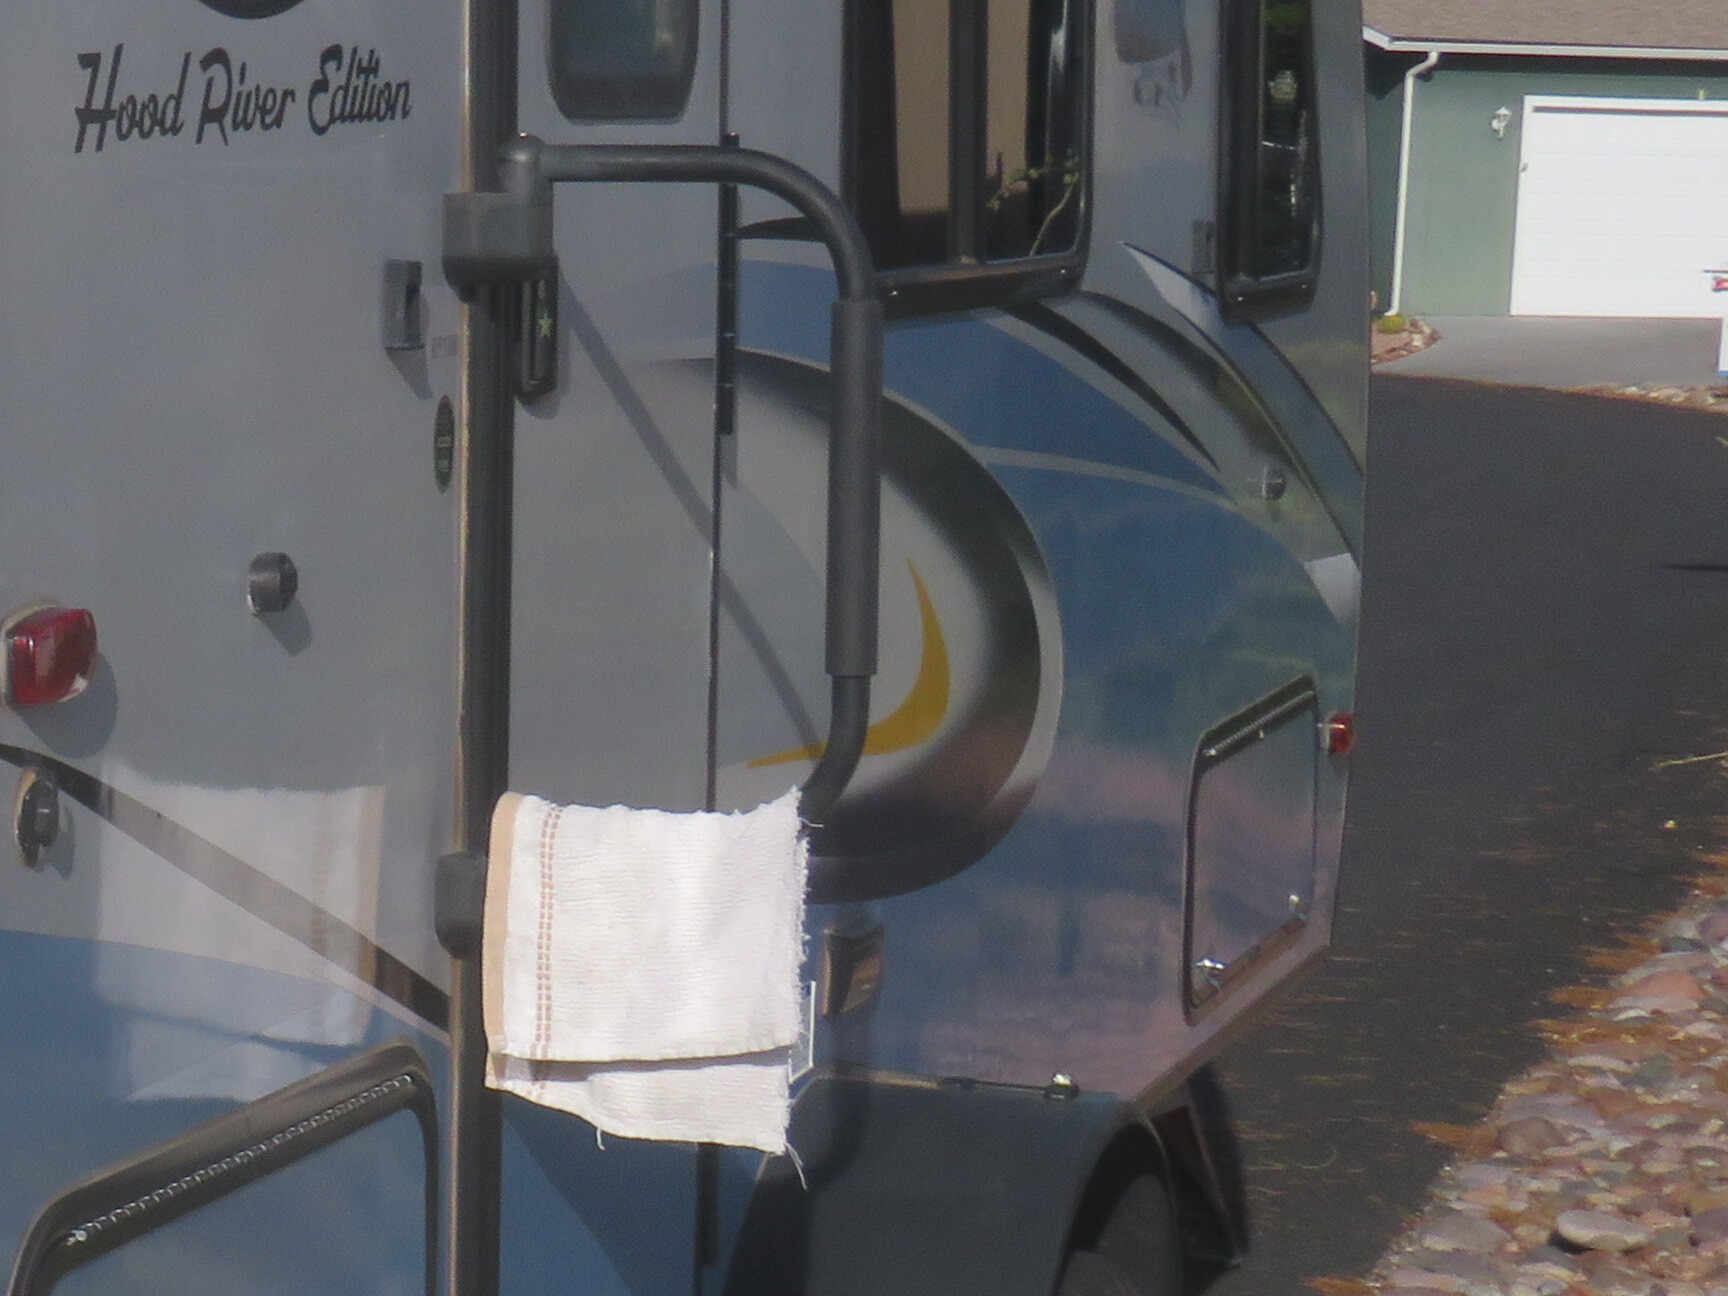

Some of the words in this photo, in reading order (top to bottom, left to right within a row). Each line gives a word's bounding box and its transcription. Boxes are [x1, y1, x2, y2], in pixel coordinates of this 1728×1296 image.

[74, 42, 191, 154] Hood
[195, 47, 296, 146] River
[308, 43, 412, 136] Edition
